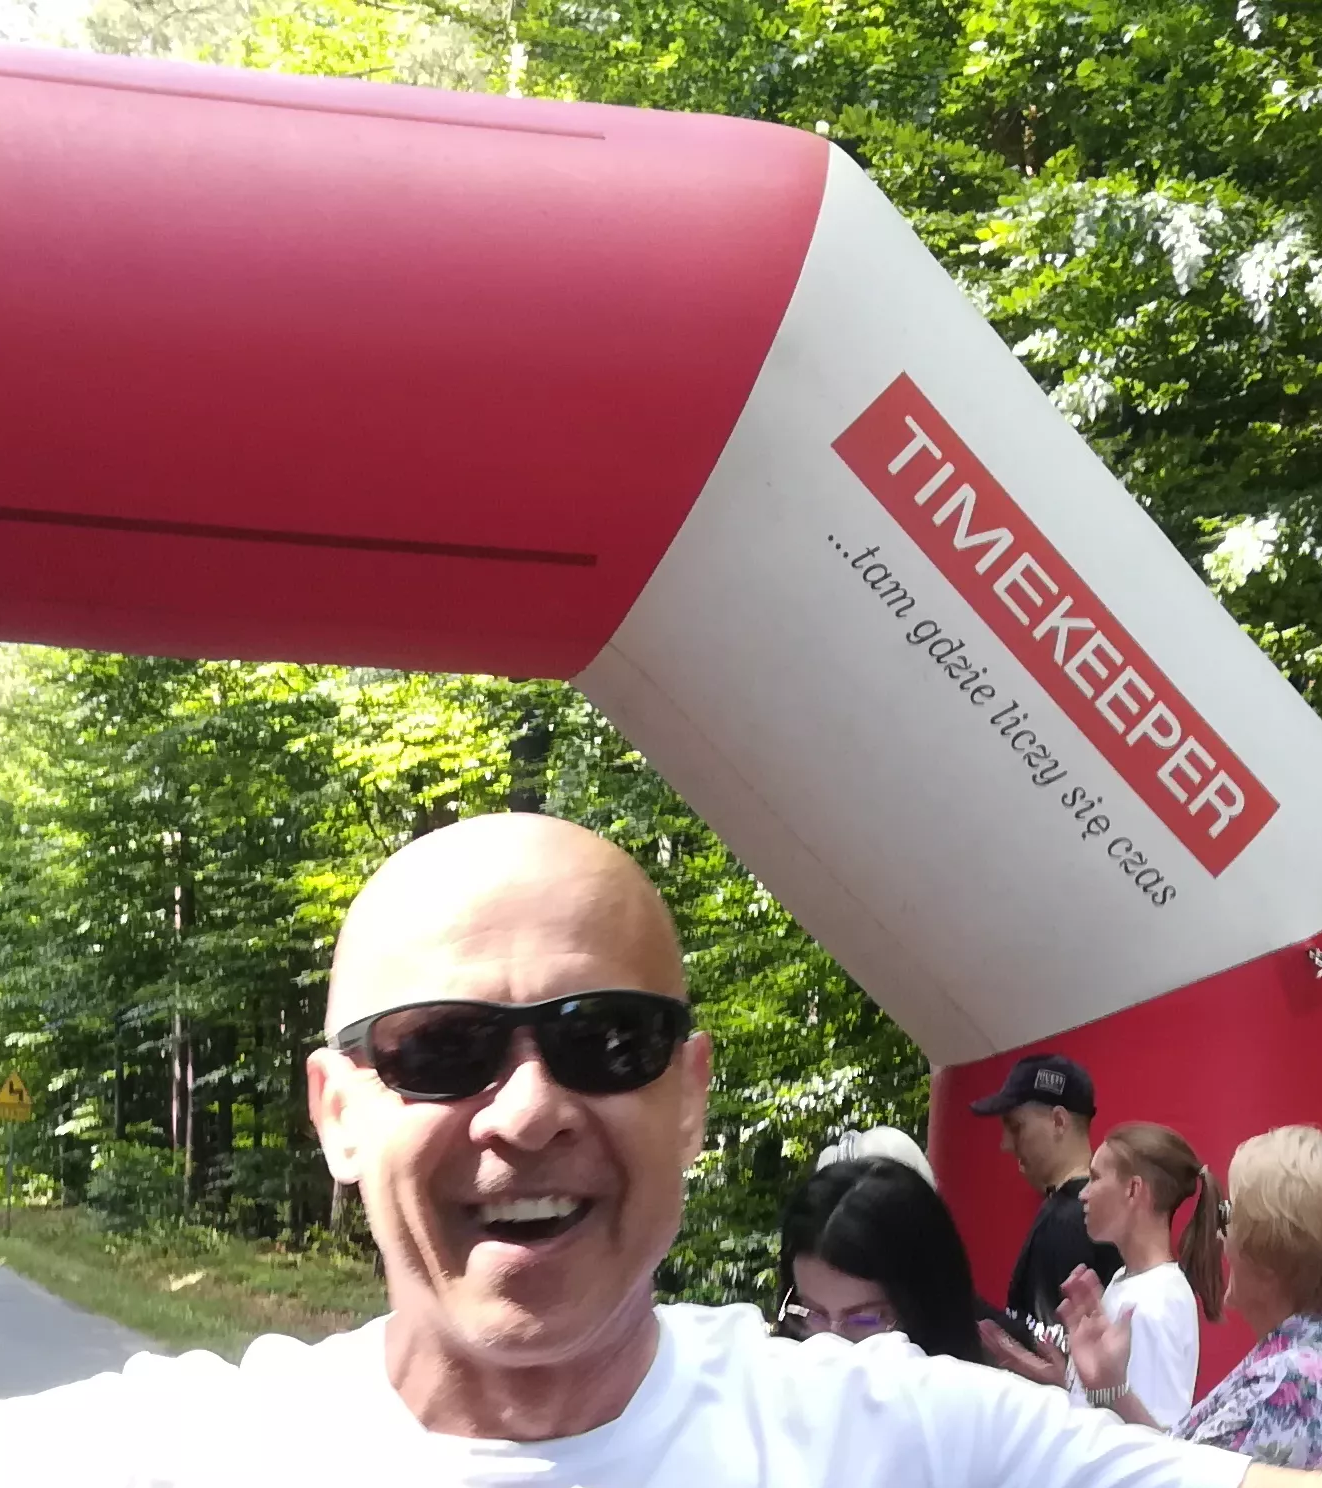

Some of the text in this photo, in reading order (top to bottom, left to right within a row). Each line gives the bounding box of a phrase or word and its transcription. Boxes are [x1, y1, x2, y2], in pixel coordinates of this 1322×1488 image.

[827, 533, 1177, 907] ...tam gdzie liczy się czas
[887, 415, 1246, 839] TIMEKEEPER
